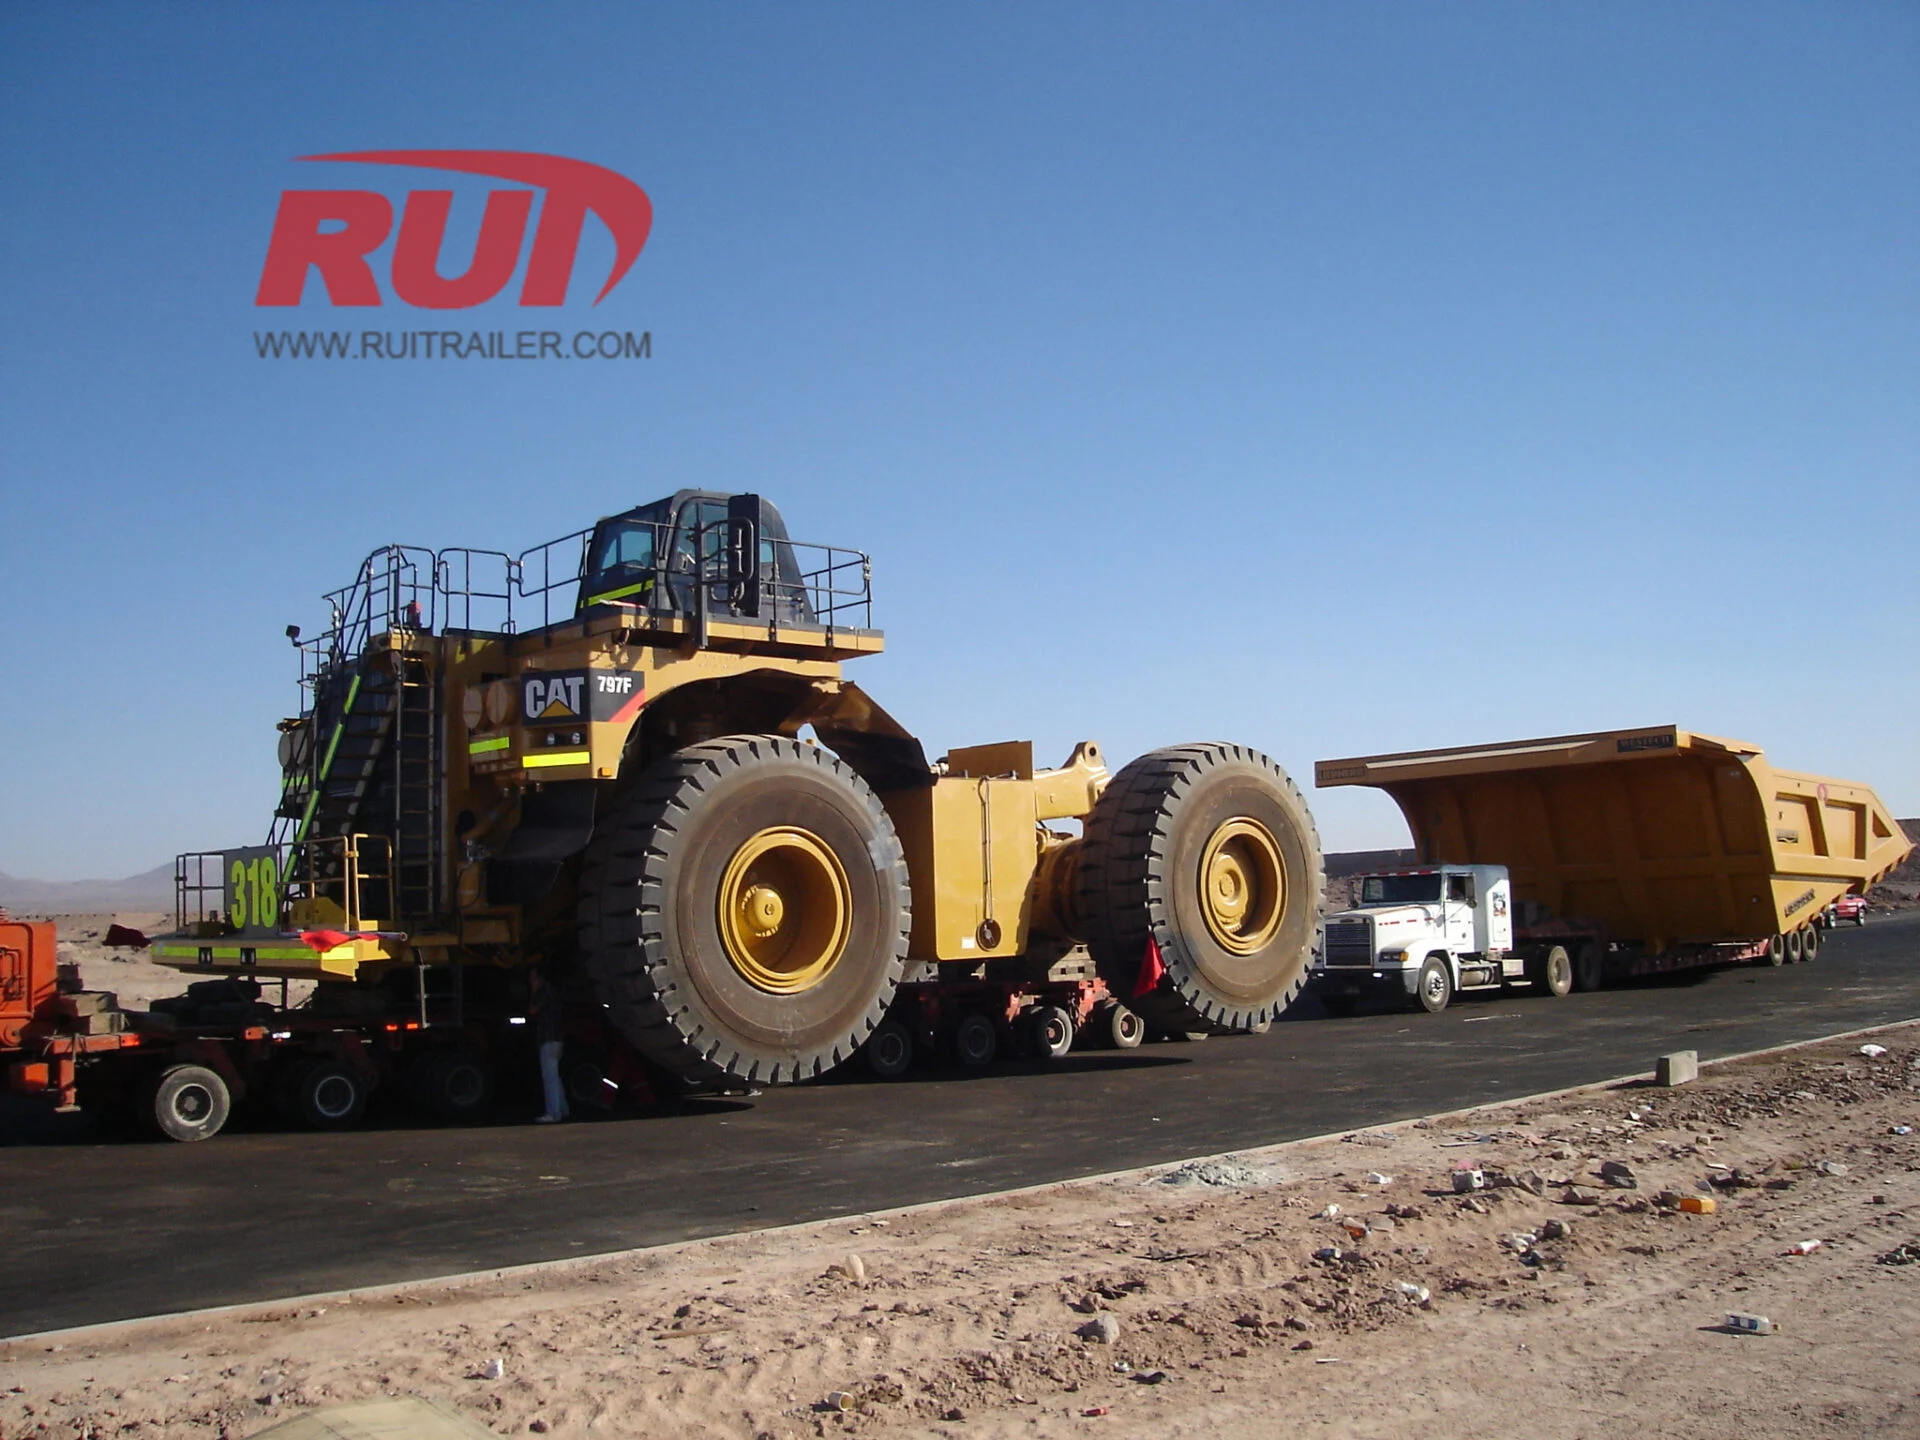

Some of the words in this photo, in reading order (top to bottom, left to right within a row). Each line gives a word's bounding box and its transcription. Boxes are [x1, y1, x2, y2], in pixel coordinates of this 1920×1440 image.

[525, 676, 585, 719] CAT
[597, 675, 632, 694] 797F
[230, 856, 278, 929] 318
